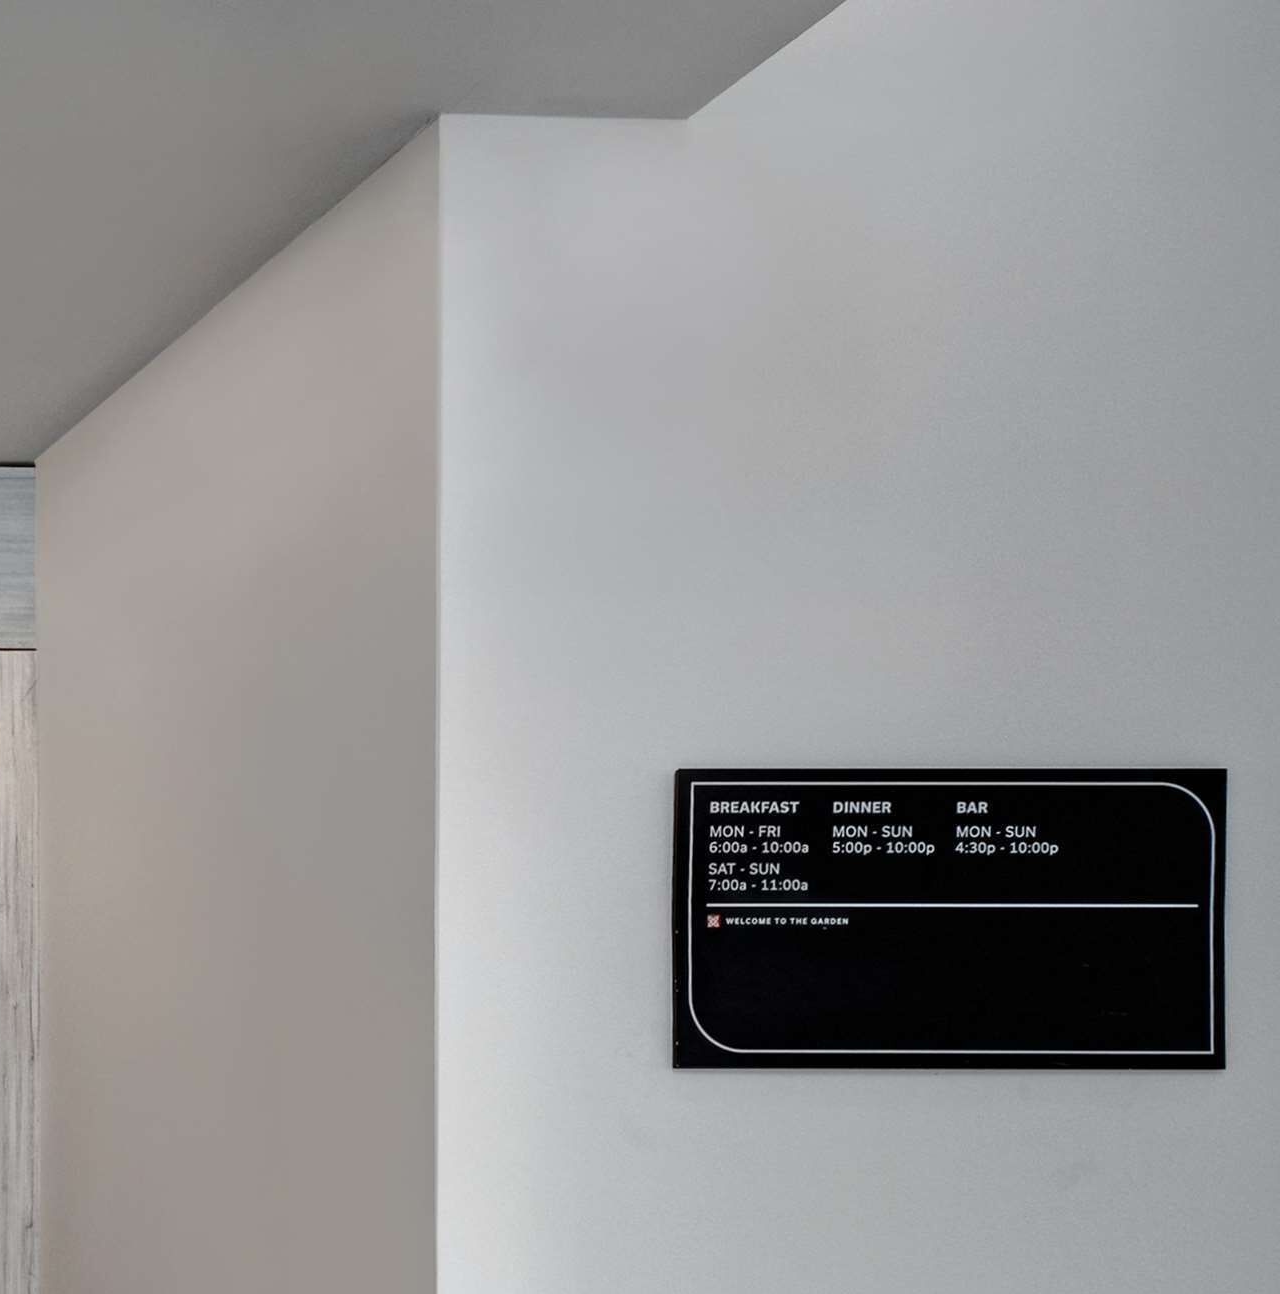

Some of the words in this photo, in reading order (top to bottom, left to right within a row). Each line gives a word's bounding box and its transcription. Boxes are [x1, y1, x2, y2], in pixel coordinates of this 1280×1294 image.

[709, 801, 800, 814] BREAKFAST
[832, 801, 892, 814] DINNER
[956, 801, 989, 814] BAR
[709, 825, 744, 838] MON
[758, 825, 781, 838] FRI
[832, 825, 868, 838] MON
[881, 825, 913, 838] SUN
[956, 825, 992, 838] MON
[1005, 825, 1037, 838] SUN
[709, 841, 748, 854] 6:00a
[762, 841, 810, 854] 10:00a
[832, 841, 872, 856] 5:00p
[886, 841, 935, 856] 10:00p
[955, 841, 996, 856] 4:30p
[1010, 841, 1059, 856] 10:00p
[708, 863, 736, 875] SAT
[749, 863, 781, 875] SUN
[708, 879, 747, 892] 7:00a
[761, 879, 809, 892] 11:00a
[725, 917, 772, 925] WELCOME
[774, 917, 787, 925] TO
[790, 917, 808, 925] THE
[810, 917, 849, 925] GARDEN
